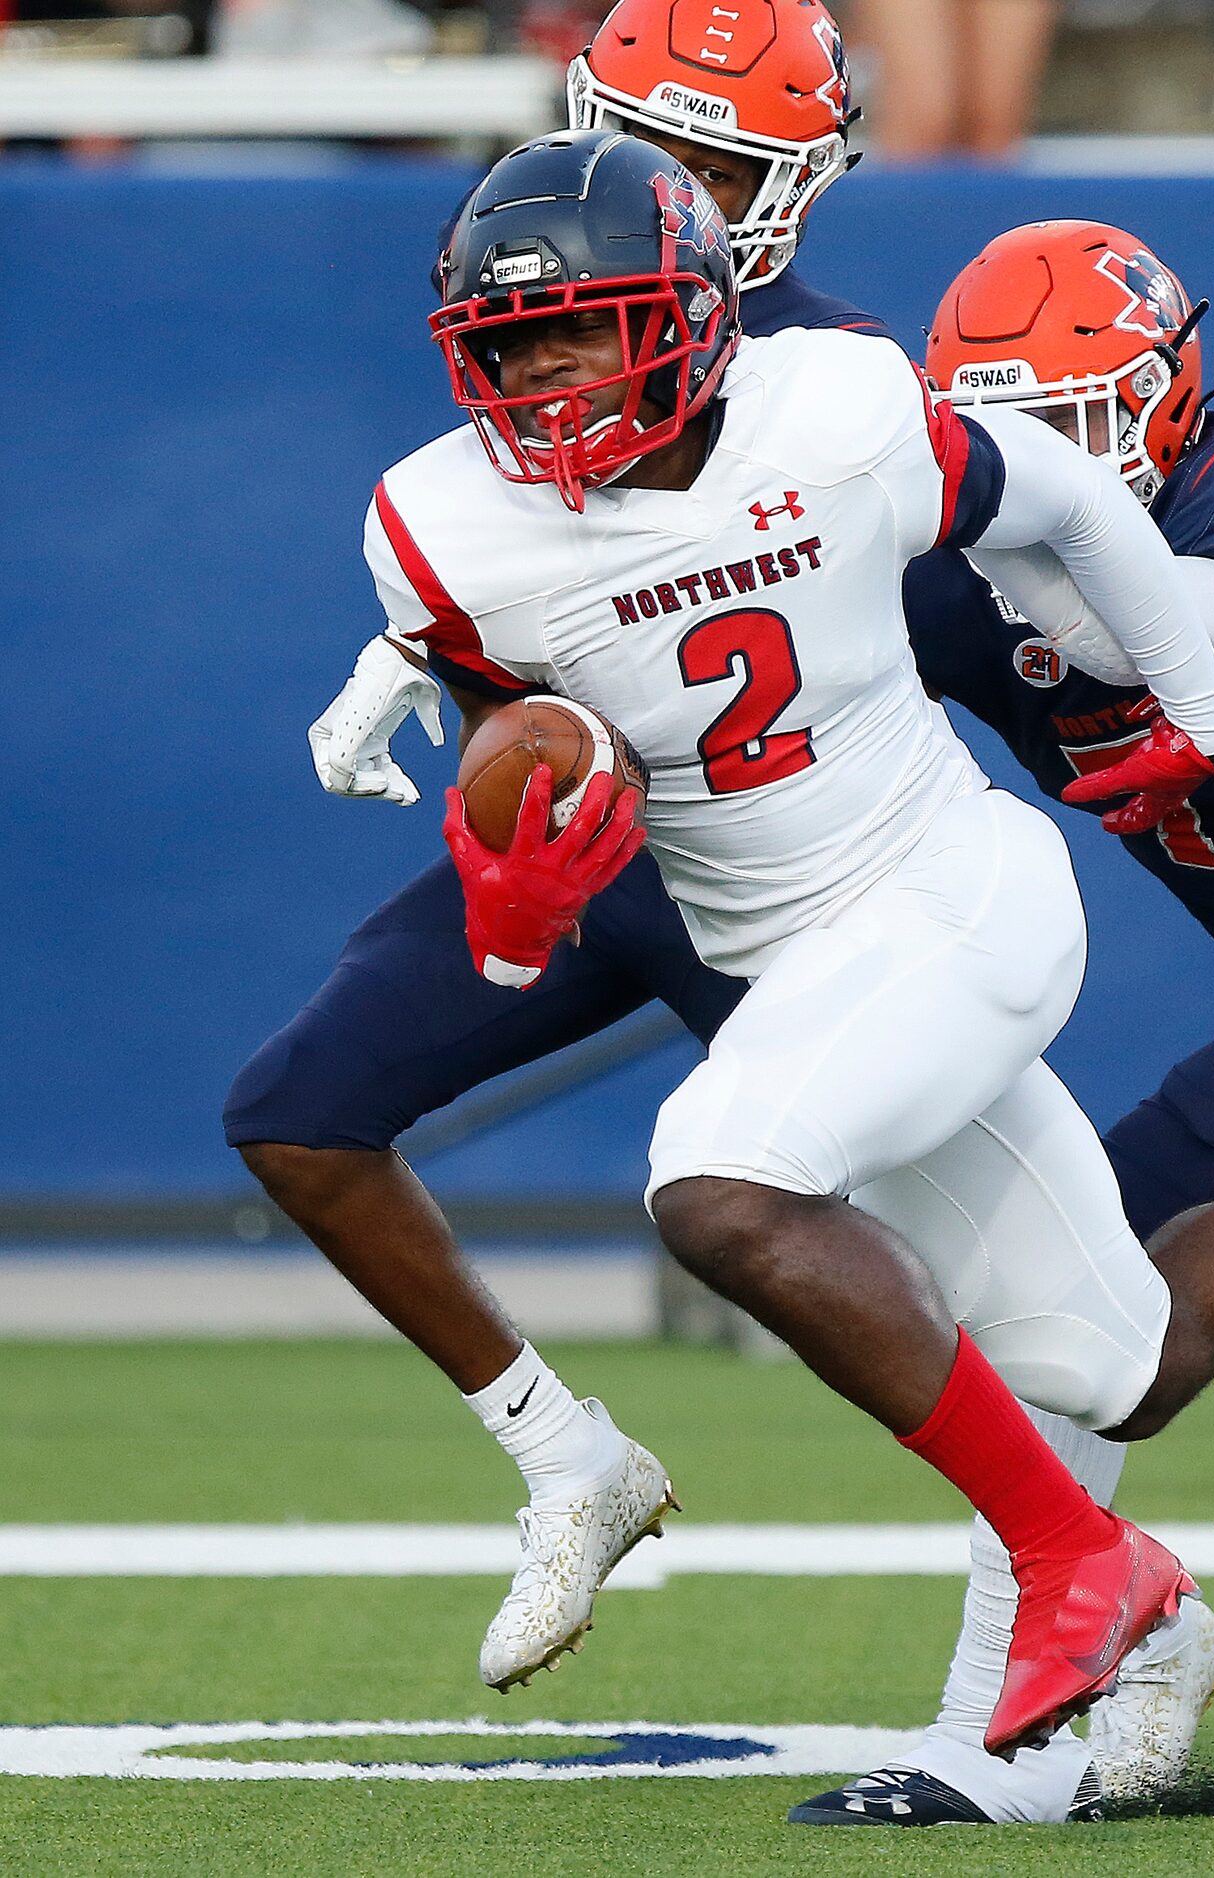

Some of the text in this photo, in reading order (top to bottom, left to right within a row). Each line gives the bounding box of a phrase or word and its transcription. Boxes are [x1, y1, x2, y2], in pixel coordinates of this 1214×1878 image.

[612, 536, 822, 627] NORTHWEST
[676, 607, 818, 795] 2
[1022, 645, 1061, 683] 21
